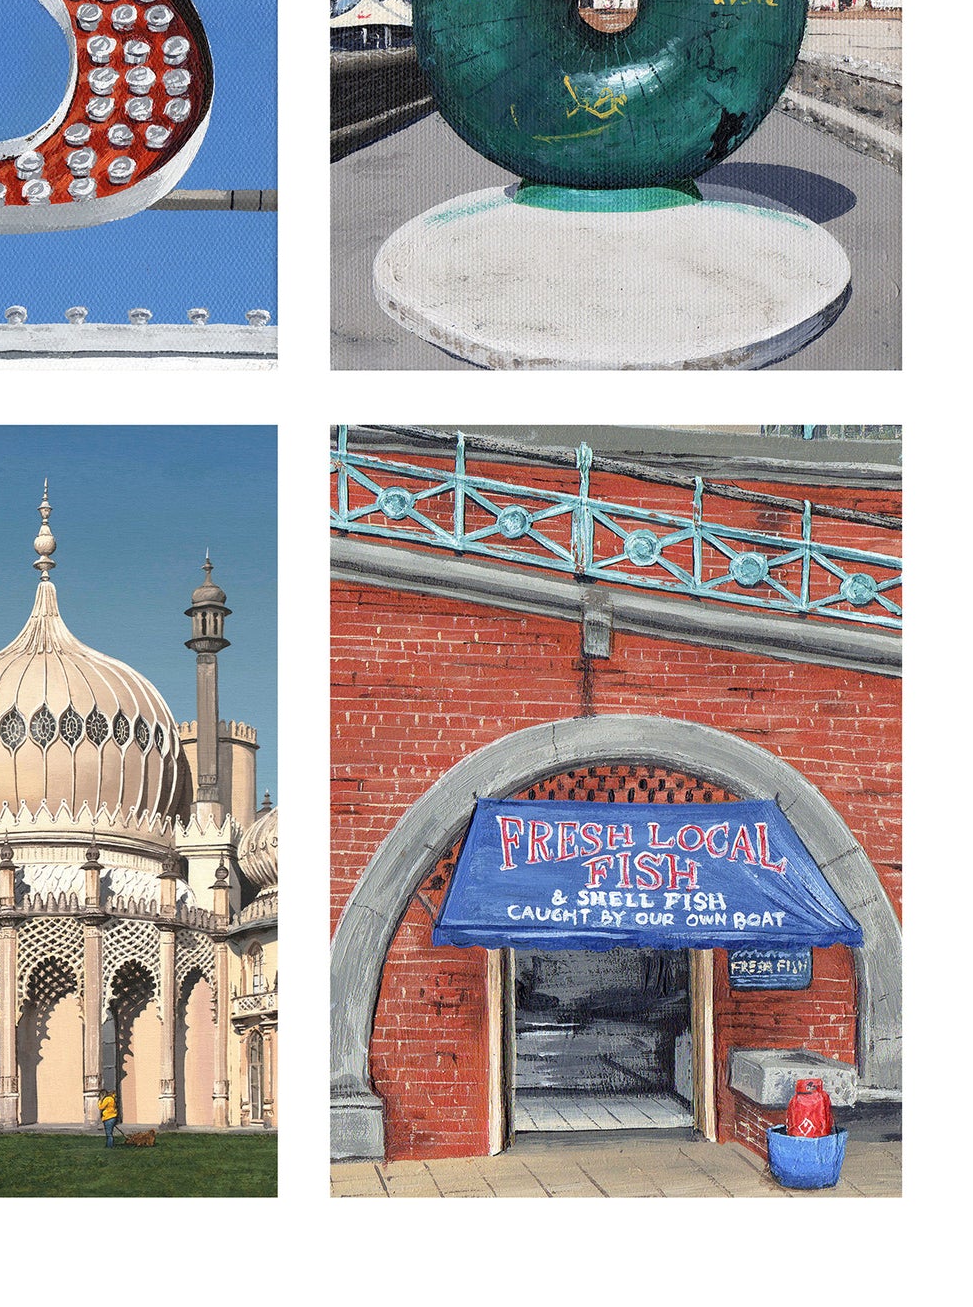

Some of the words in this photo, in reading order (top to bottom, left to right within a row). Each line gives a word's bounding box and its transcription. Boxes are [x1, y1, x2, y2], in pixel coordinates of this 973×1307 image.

[495, 815, 636, 871] FRESH
[648, 821, 789, 874] LOCAL
[580, 851, 701, 891] FISH
[551, 889, 568, 906] &
[577, 890, 656, 908] SHELL
[663, 892, 728, 911] FISH
[506, 904, 592, 926] CAUGHT
[600, 910, 627, 927] BY
[635, 911, 676, 927] OUR
[686, 912, 727, 927] OWN
[733, 911, 787, 930] BOAT
